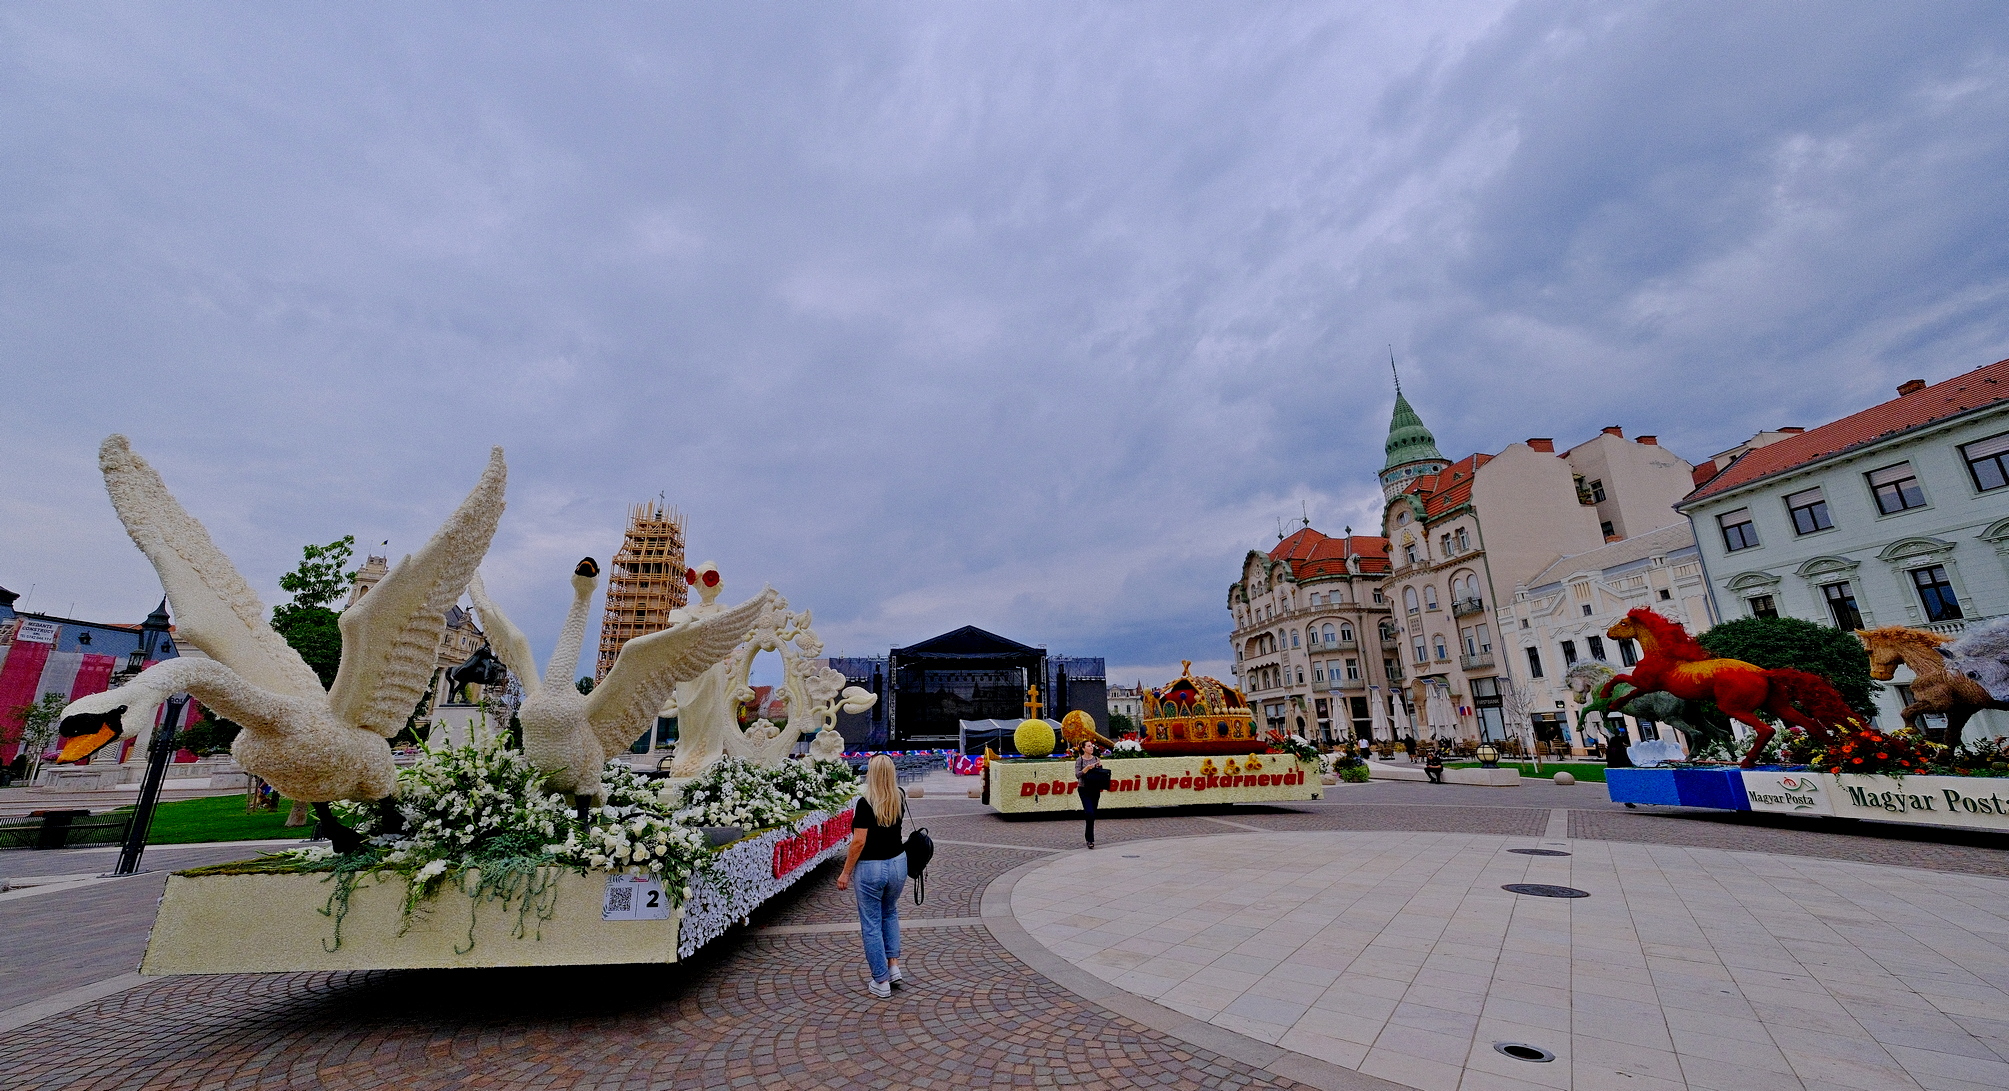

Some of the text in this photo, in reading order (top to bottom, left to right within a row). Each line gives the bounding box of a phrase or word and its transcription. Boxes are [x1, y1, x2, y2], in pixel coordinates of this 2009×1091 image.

[22, 626, 54, 634] CONSTRUCT
[1020, 767, 1305, 797] Debreni Virágkarnevál
[1748, 791, 1815, 805] Magyar Posta
[1847, 786, 2009, 815] Magyar Post
[646, 890, 659, 908] 2
